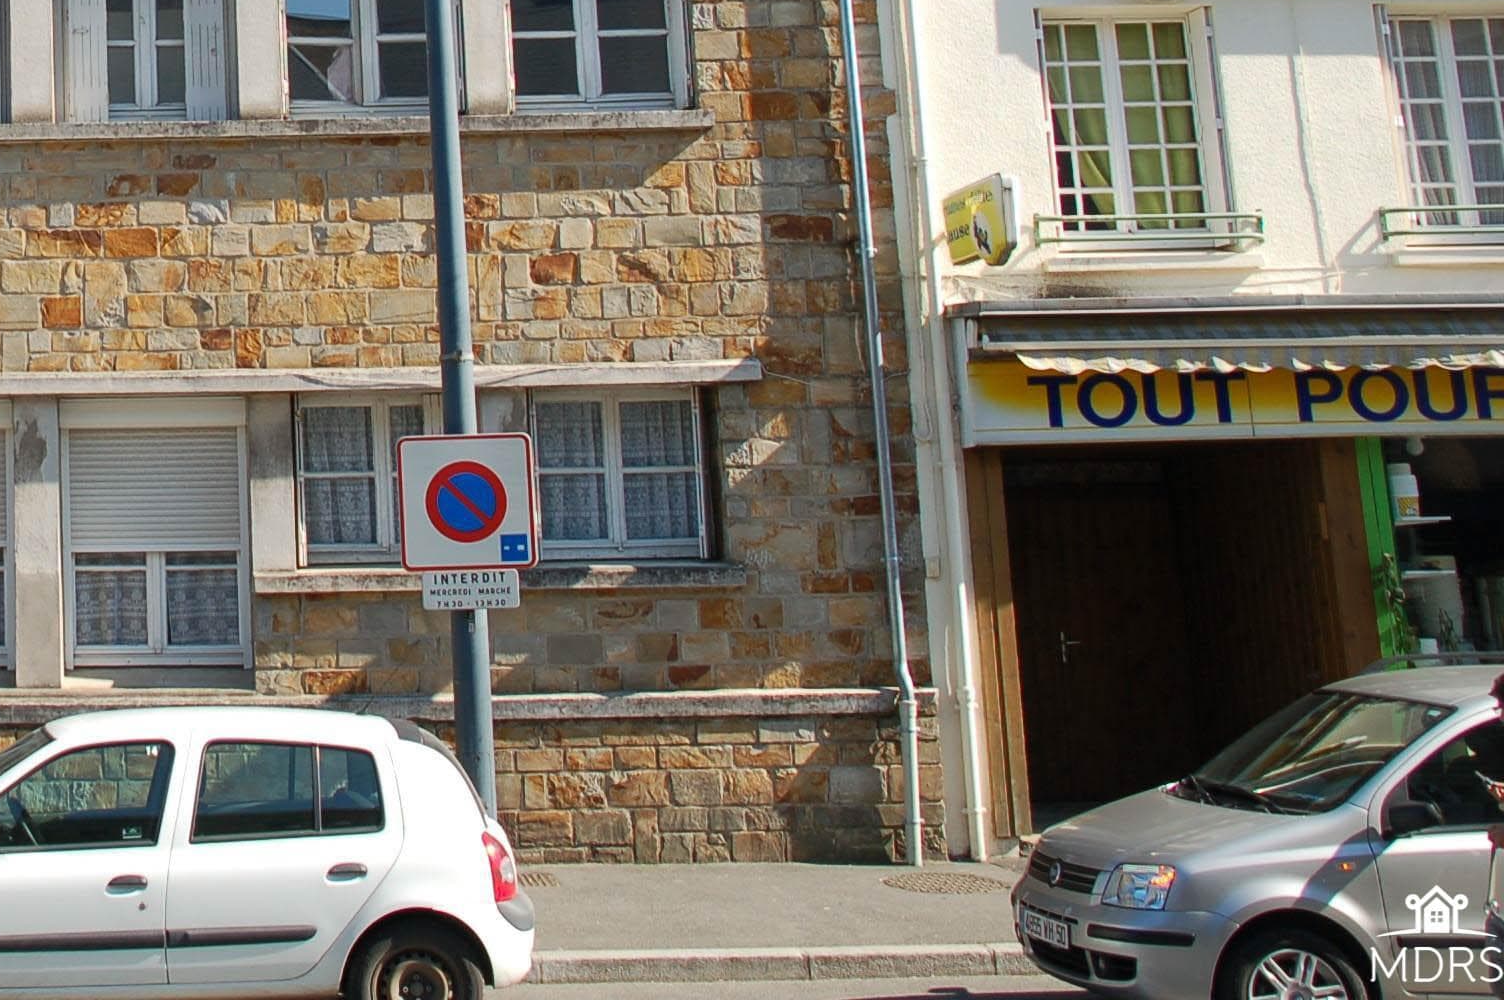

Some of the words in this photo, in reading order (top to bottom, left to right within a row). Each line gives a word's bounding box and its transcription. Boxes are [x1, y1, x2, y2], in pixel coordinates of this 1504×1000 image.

[1027, 370, 1245, 428] TOUT
[433, 571, 506, 585] INTERDIT
[430, 588, 471, 597] MERCREDI
